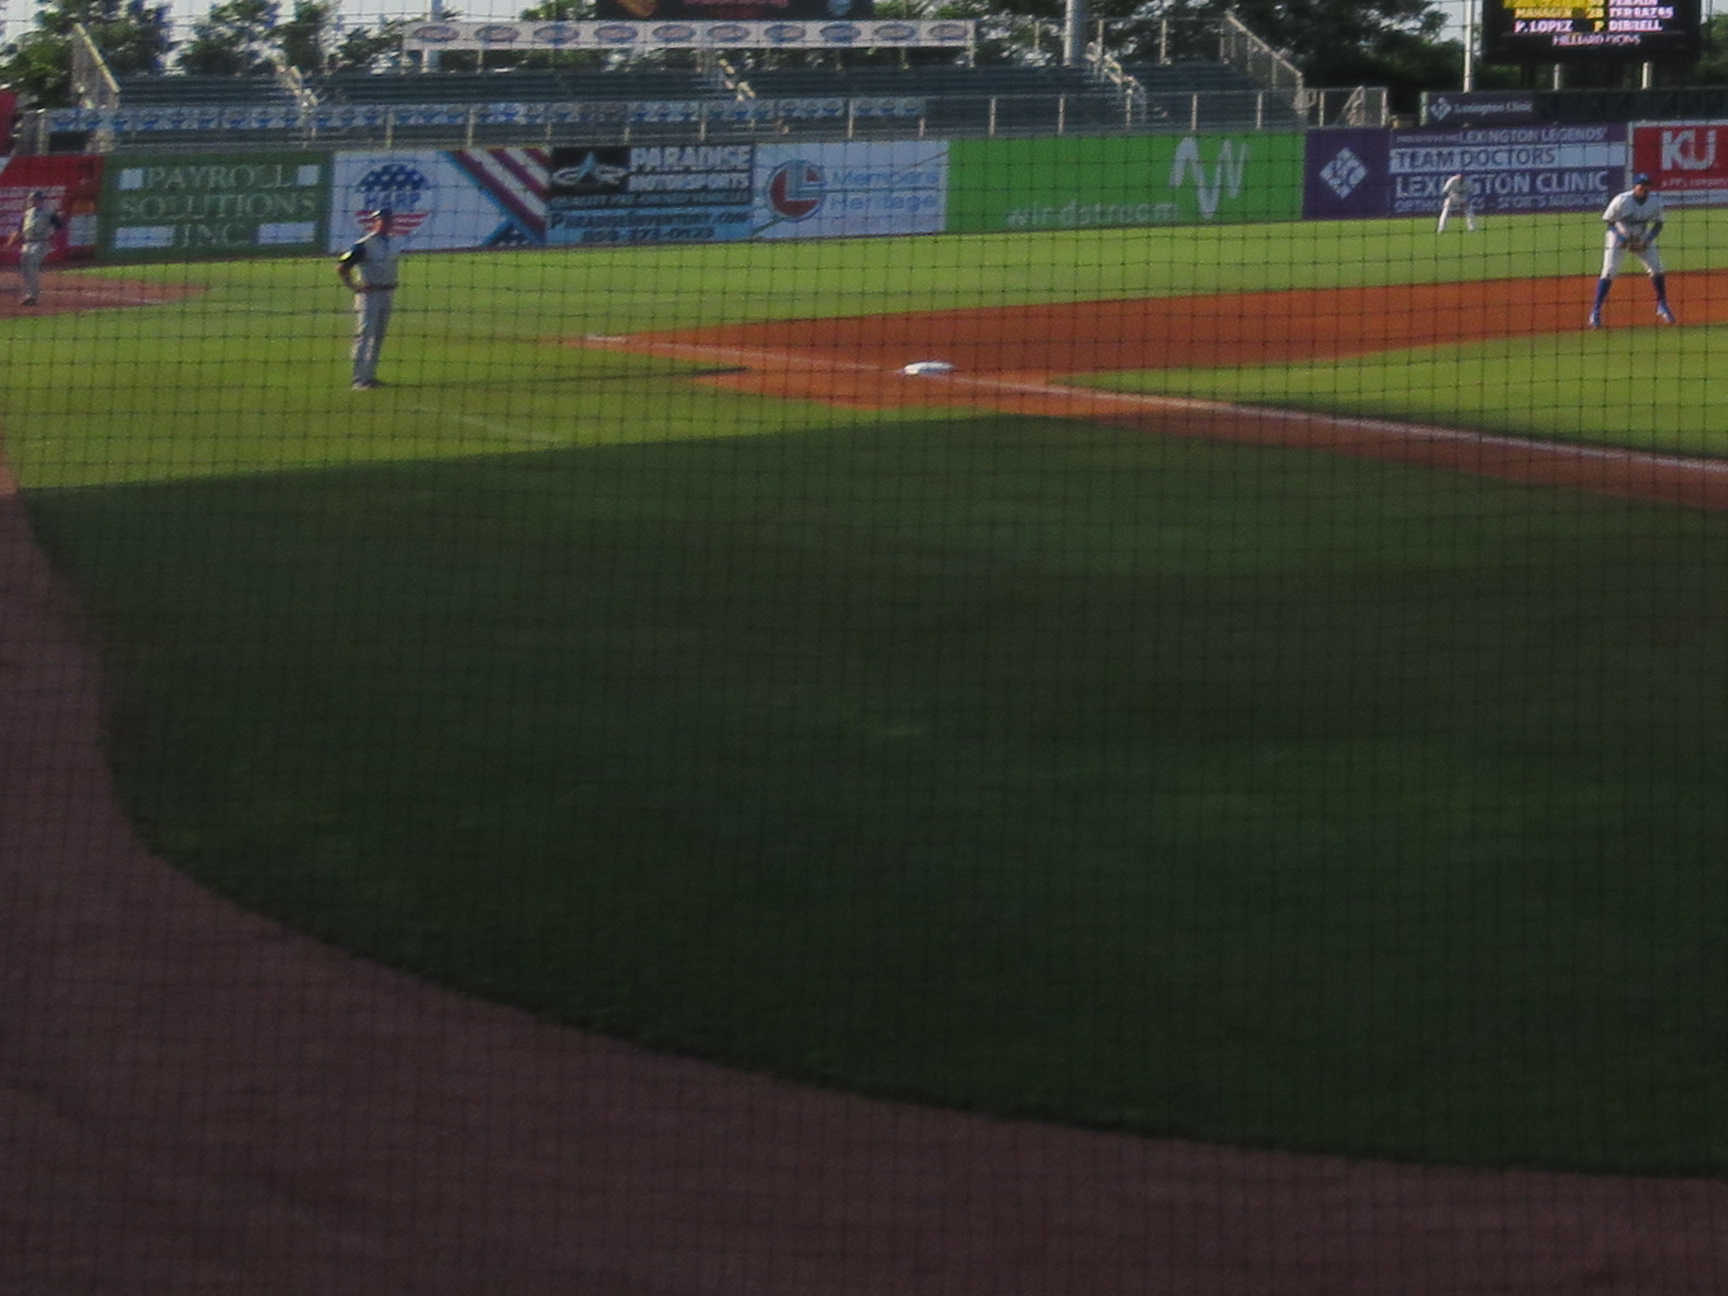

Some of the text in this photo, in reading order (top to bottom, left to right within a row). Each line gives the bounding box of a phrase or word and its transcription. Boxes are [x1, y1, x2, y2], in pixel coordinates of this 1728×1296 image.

[1457, 128, 1538, 145] LEXINGTON
[1395, 148, 1557, 169] TEAM DOCTORS
[1661, 129, 1718, 171] KU
[147, 164, 292, 190] PAYROLL
[1535, 170, 1610, 194] CLINIC
[119, 192, 318, 221] SOLUTIONS
[182, 221, 252, 247] INC
